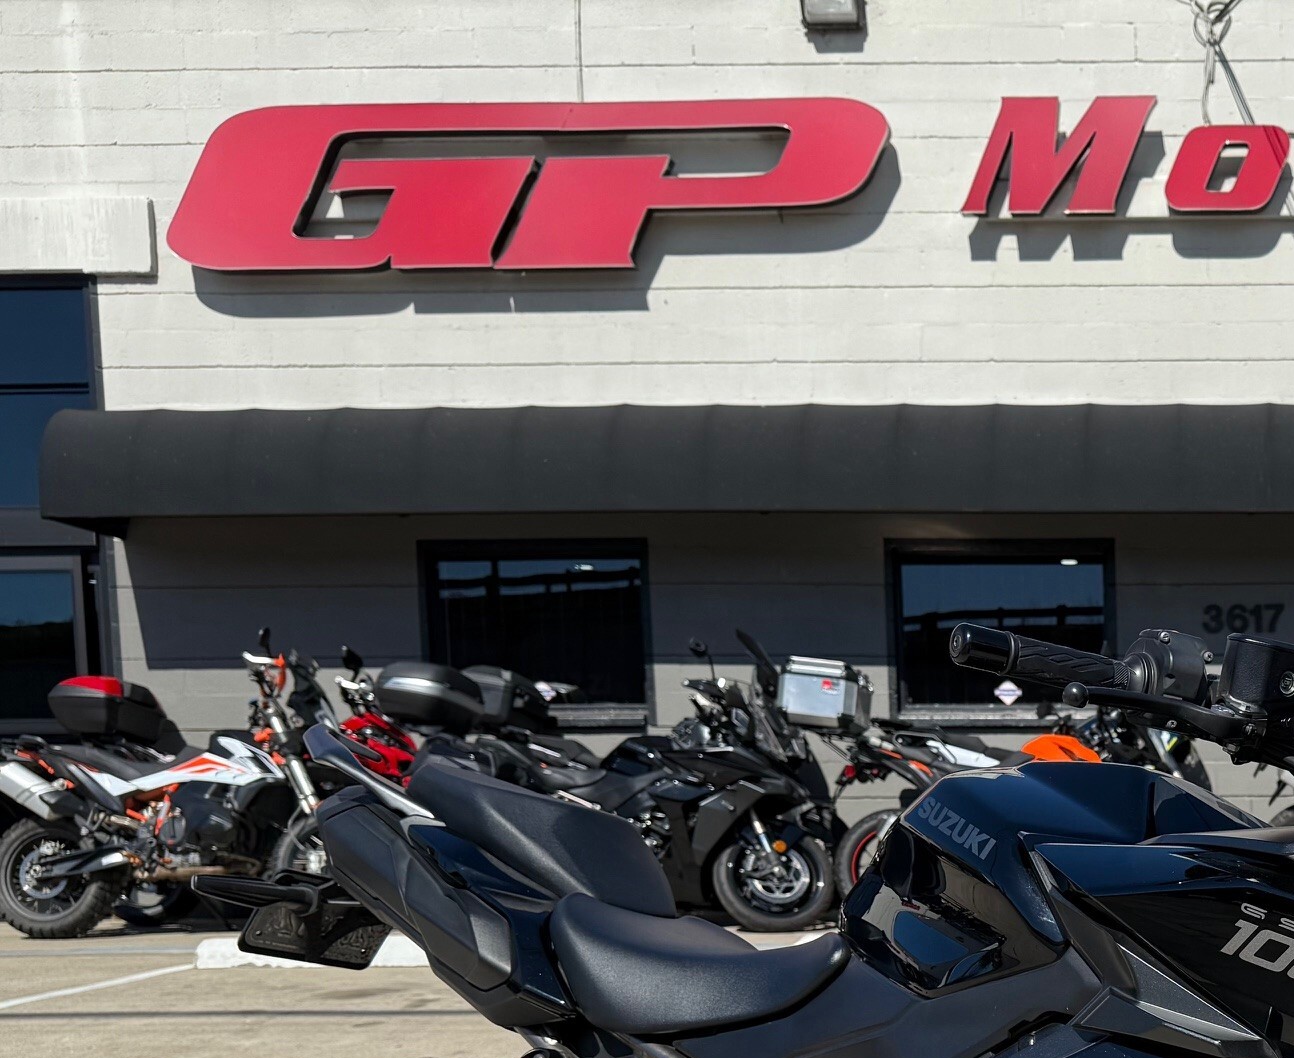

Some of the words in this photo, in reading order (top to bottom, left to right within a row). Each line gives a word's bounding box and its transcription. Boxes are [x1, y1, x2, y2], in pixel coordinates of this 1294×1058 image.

[166, 97, 891, 271] GP
[1202, 603, 1285, 634] 3617
[917, 796, 997, 861] SUZUKI
